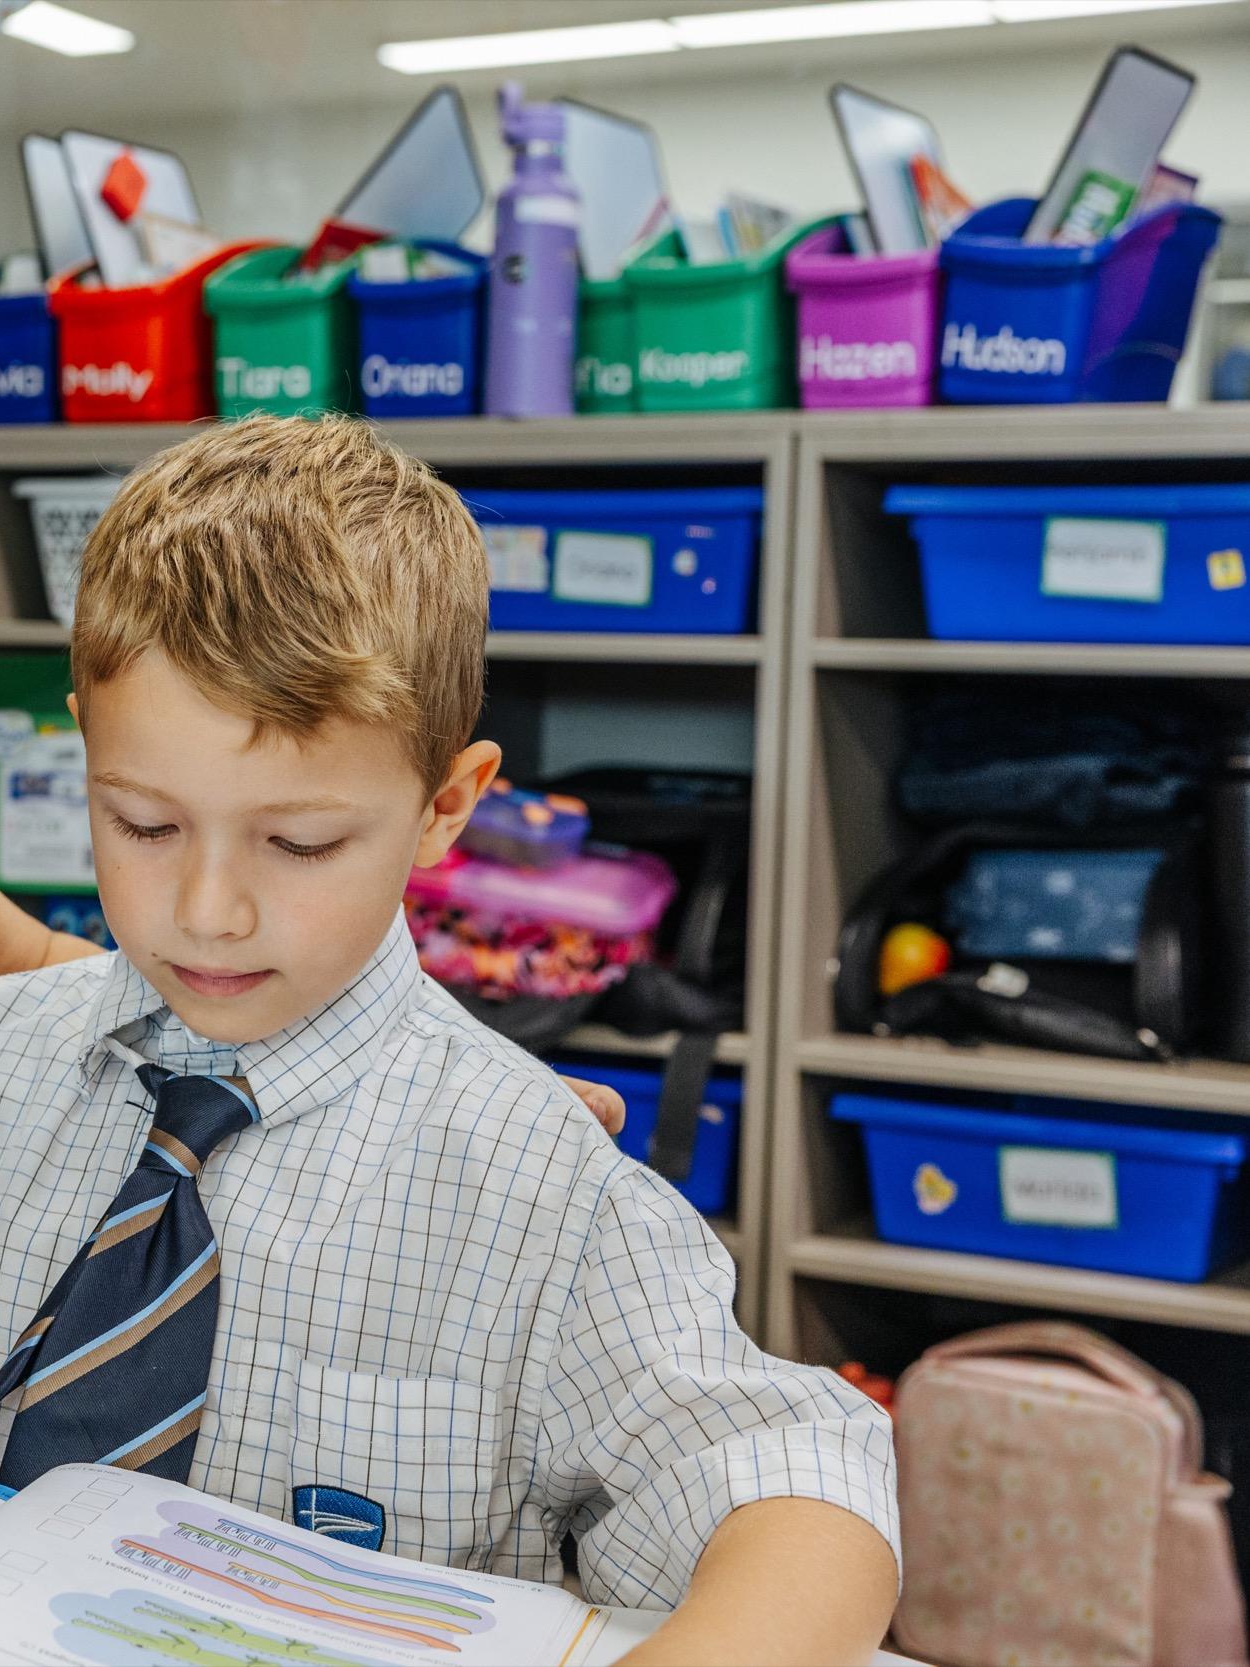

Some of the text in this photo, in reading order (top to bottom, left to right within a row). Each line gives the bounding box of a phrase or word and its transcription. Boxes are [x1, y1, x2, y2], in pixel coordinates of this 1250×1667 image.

[798, 333, 917, 382] Hazen
[940, 322, 1066, 375] Hudson
[104, 1560, 149, 1581] longest
[182, 1588, 231, 1609] shortest
